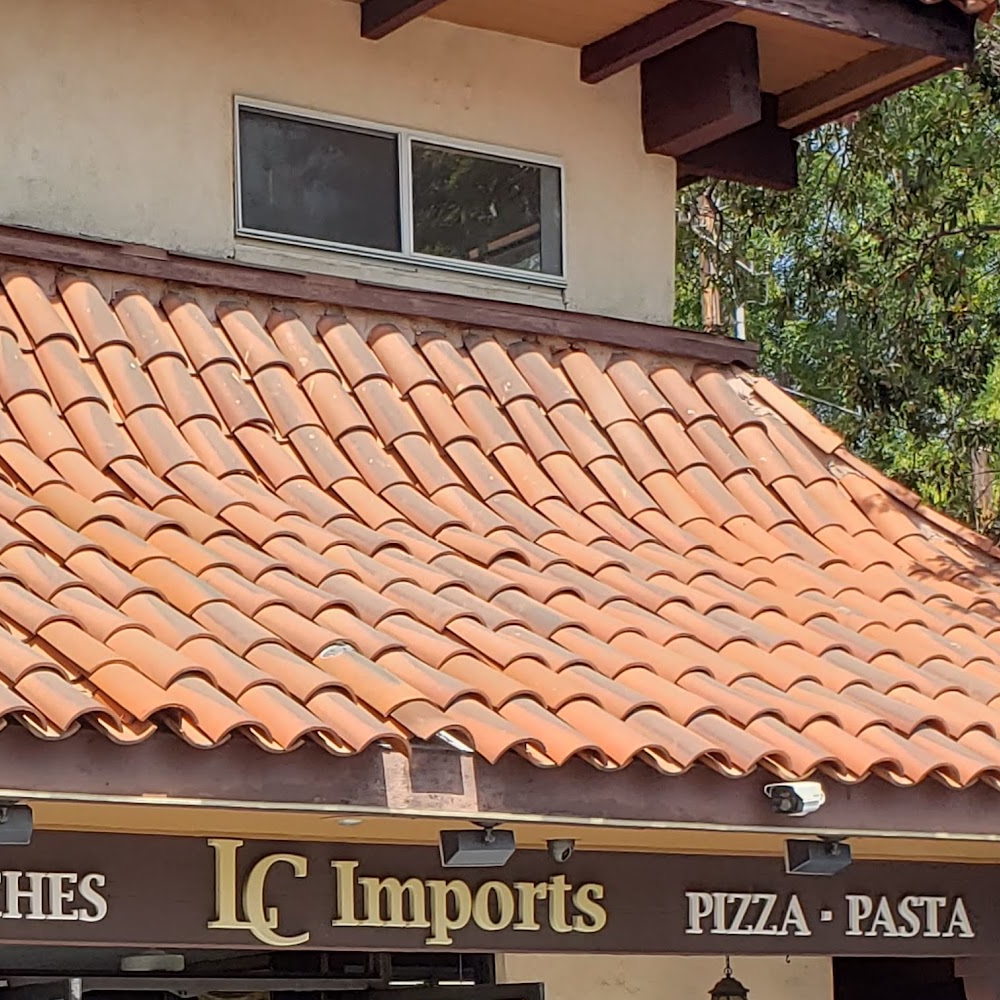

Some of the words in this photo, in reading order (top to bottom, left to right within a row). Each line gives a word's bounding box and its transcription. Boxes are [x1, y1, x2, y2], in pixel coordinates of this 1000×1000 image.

[207, 839, 310, 946] LC
[330, 859, 608, 946] Imports
[684, 890, 812, 938] PIZZA
[844, 893, 976, 939] PASTA
